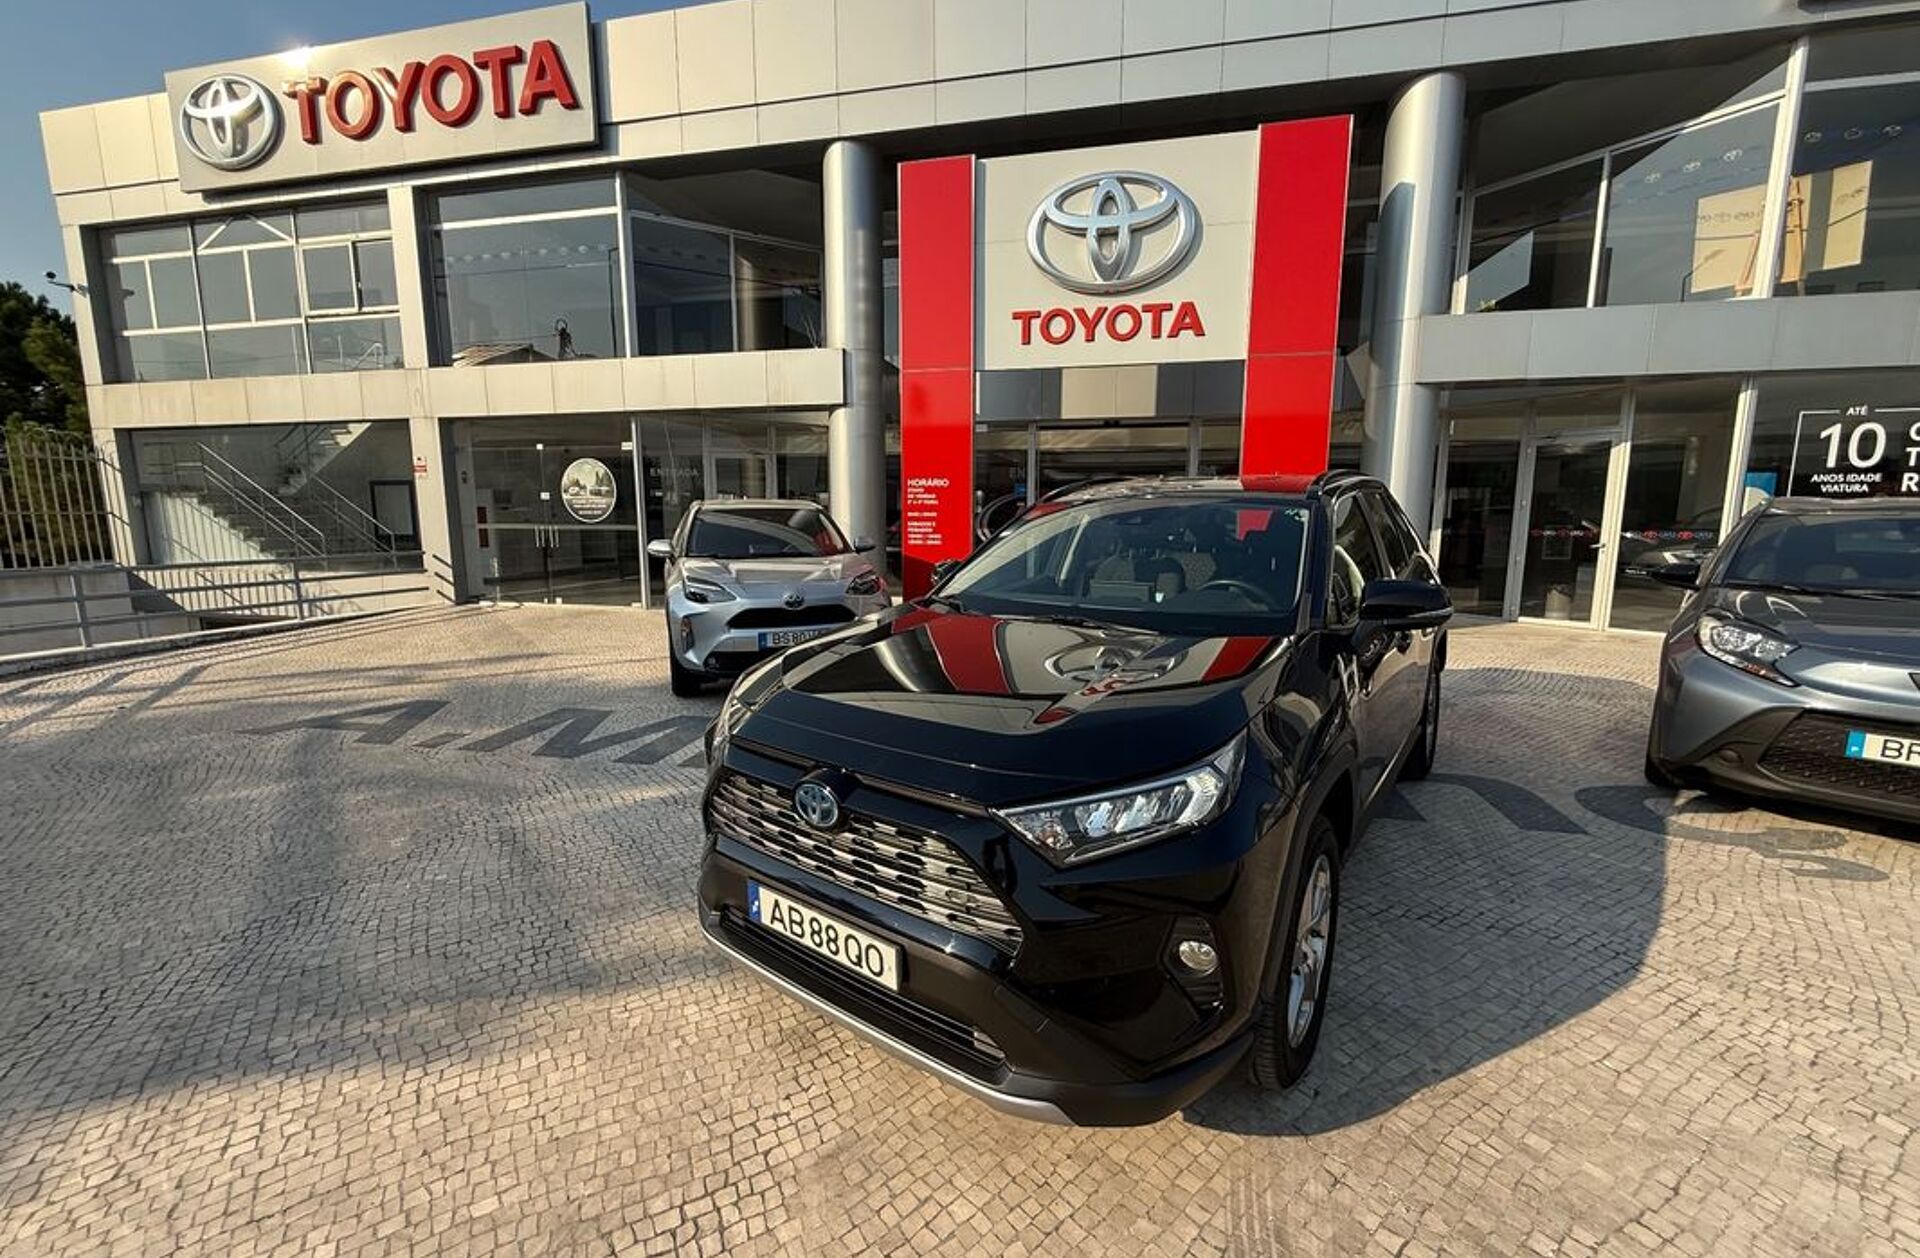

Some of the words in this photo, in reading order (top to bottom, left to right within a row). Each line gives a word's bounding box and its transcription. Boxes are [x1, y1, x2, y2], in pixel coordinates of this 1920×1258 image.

[282, 37, 581, 146] TOYOTA
[1011, 299, 1207, 346] TOYOTA
[1845, 405, 1868, 416] ATÉ
[1819, 421, 1887, 469] 10
[1810, 473, 1845, 483] ANOS
[1846, 472, 1882, 483] IDADE
[1820, 483, 1869, 493] VIATURA
